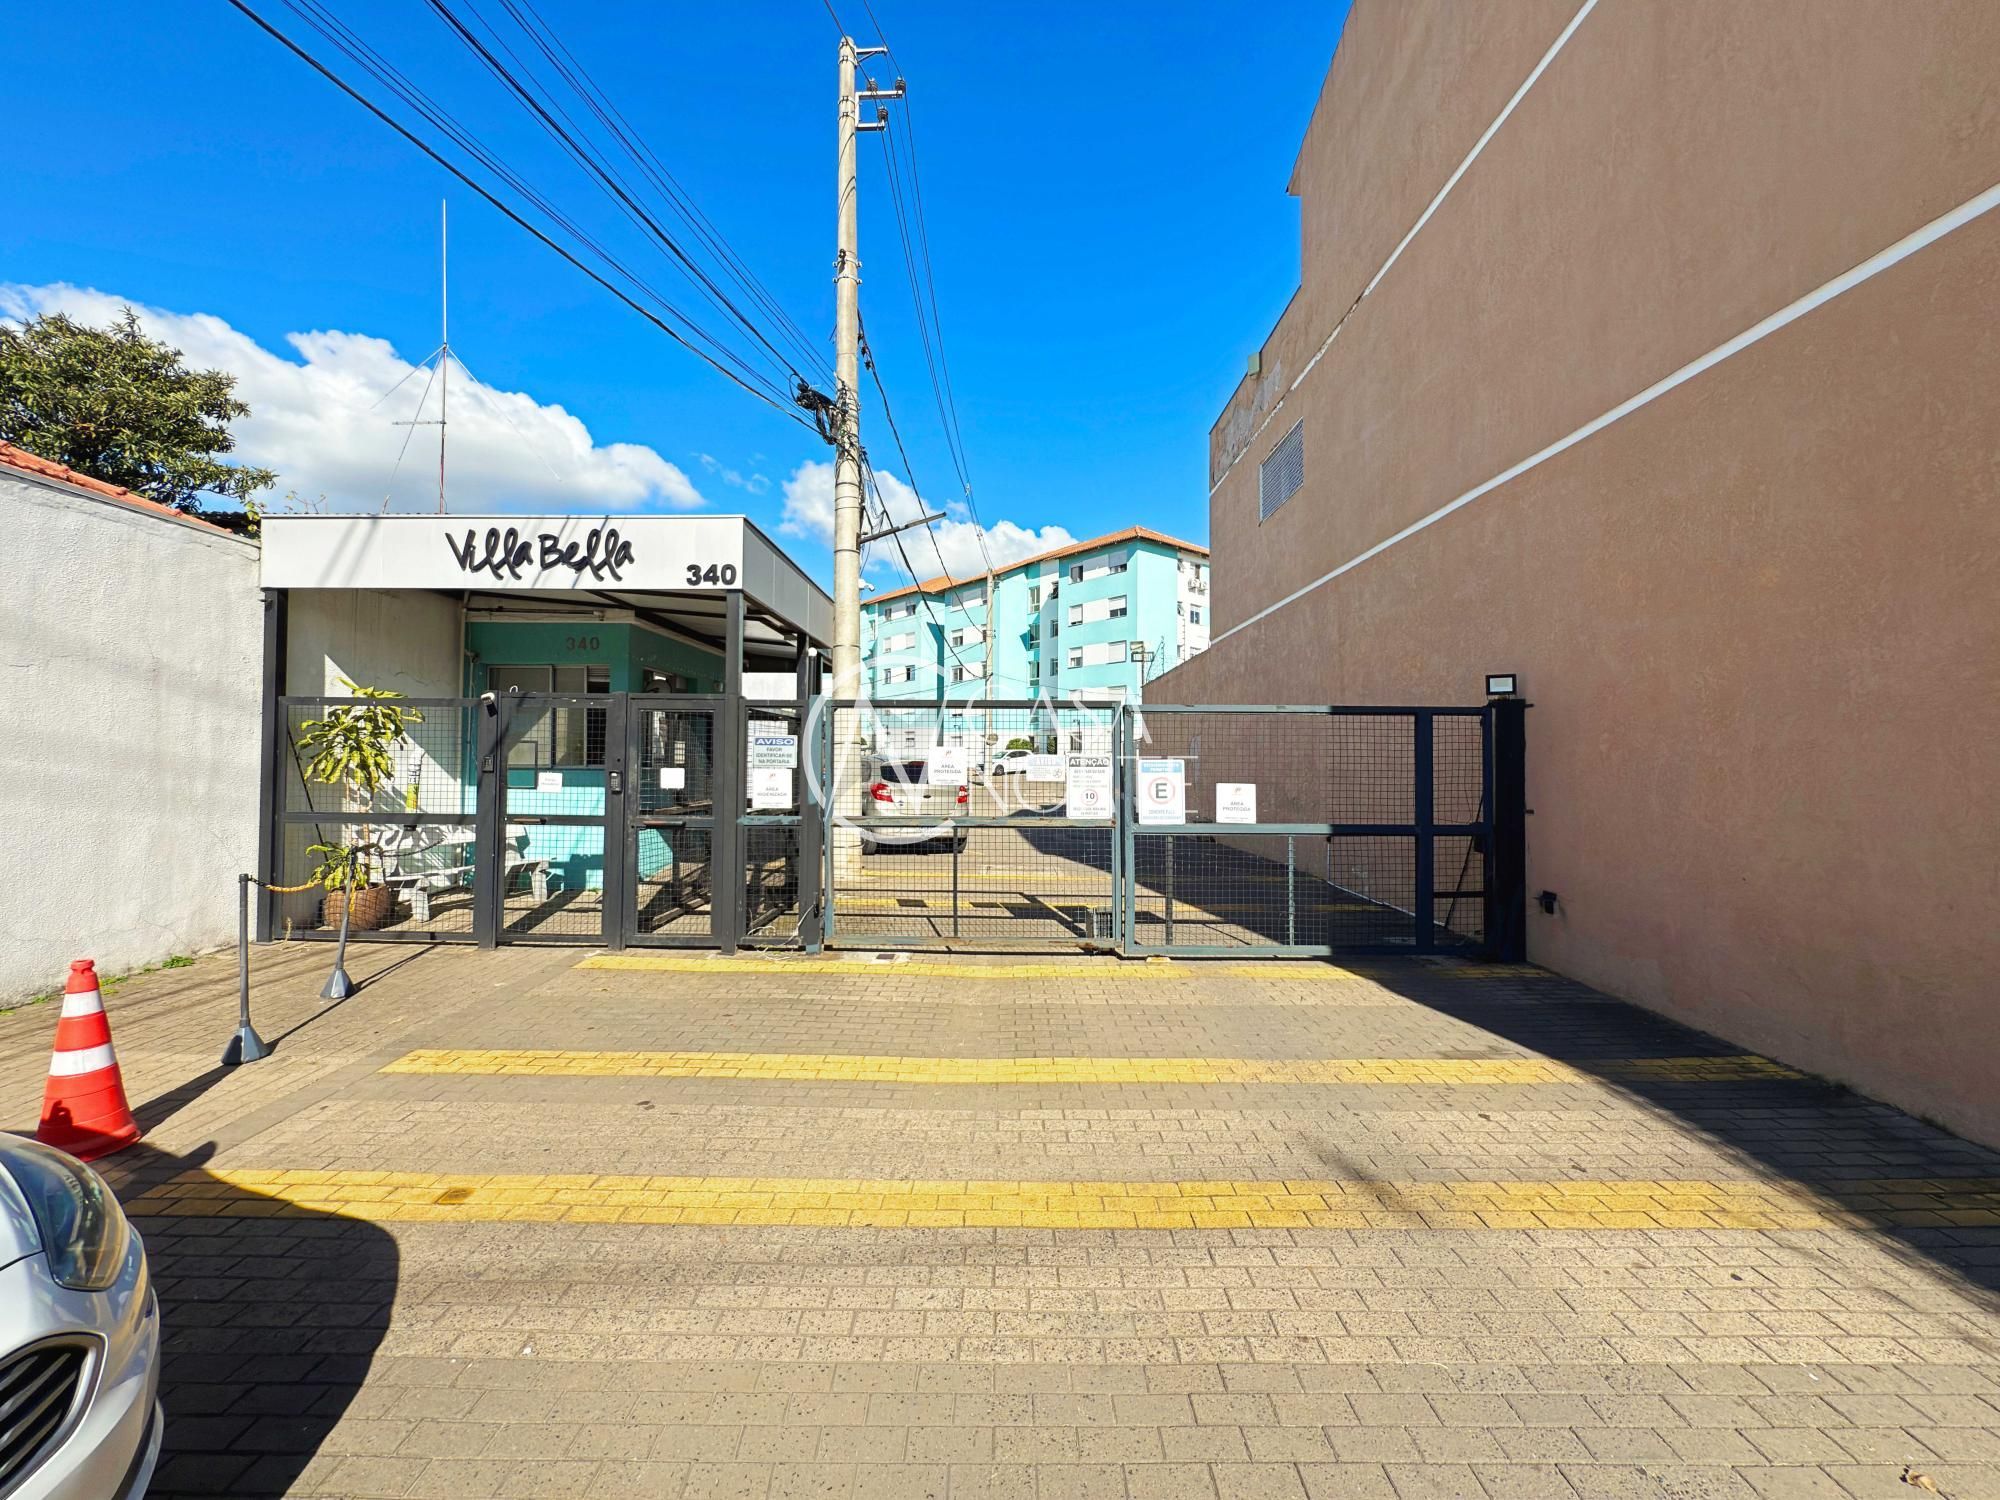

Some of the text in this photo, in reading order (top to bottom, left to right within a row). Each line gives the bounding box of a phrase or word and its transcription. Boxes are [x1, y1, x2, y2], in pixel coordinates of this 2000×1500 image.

[444, 526, 636, 582] Villa Bella
[685, 563, 738, 587] 340
[565, 635, 601, 651] 340
[756, 738, 794, 746] AVISO
[1070, 757, 1109, 767] ATENÇÃO
[1155, 783, 1168, 799] E
